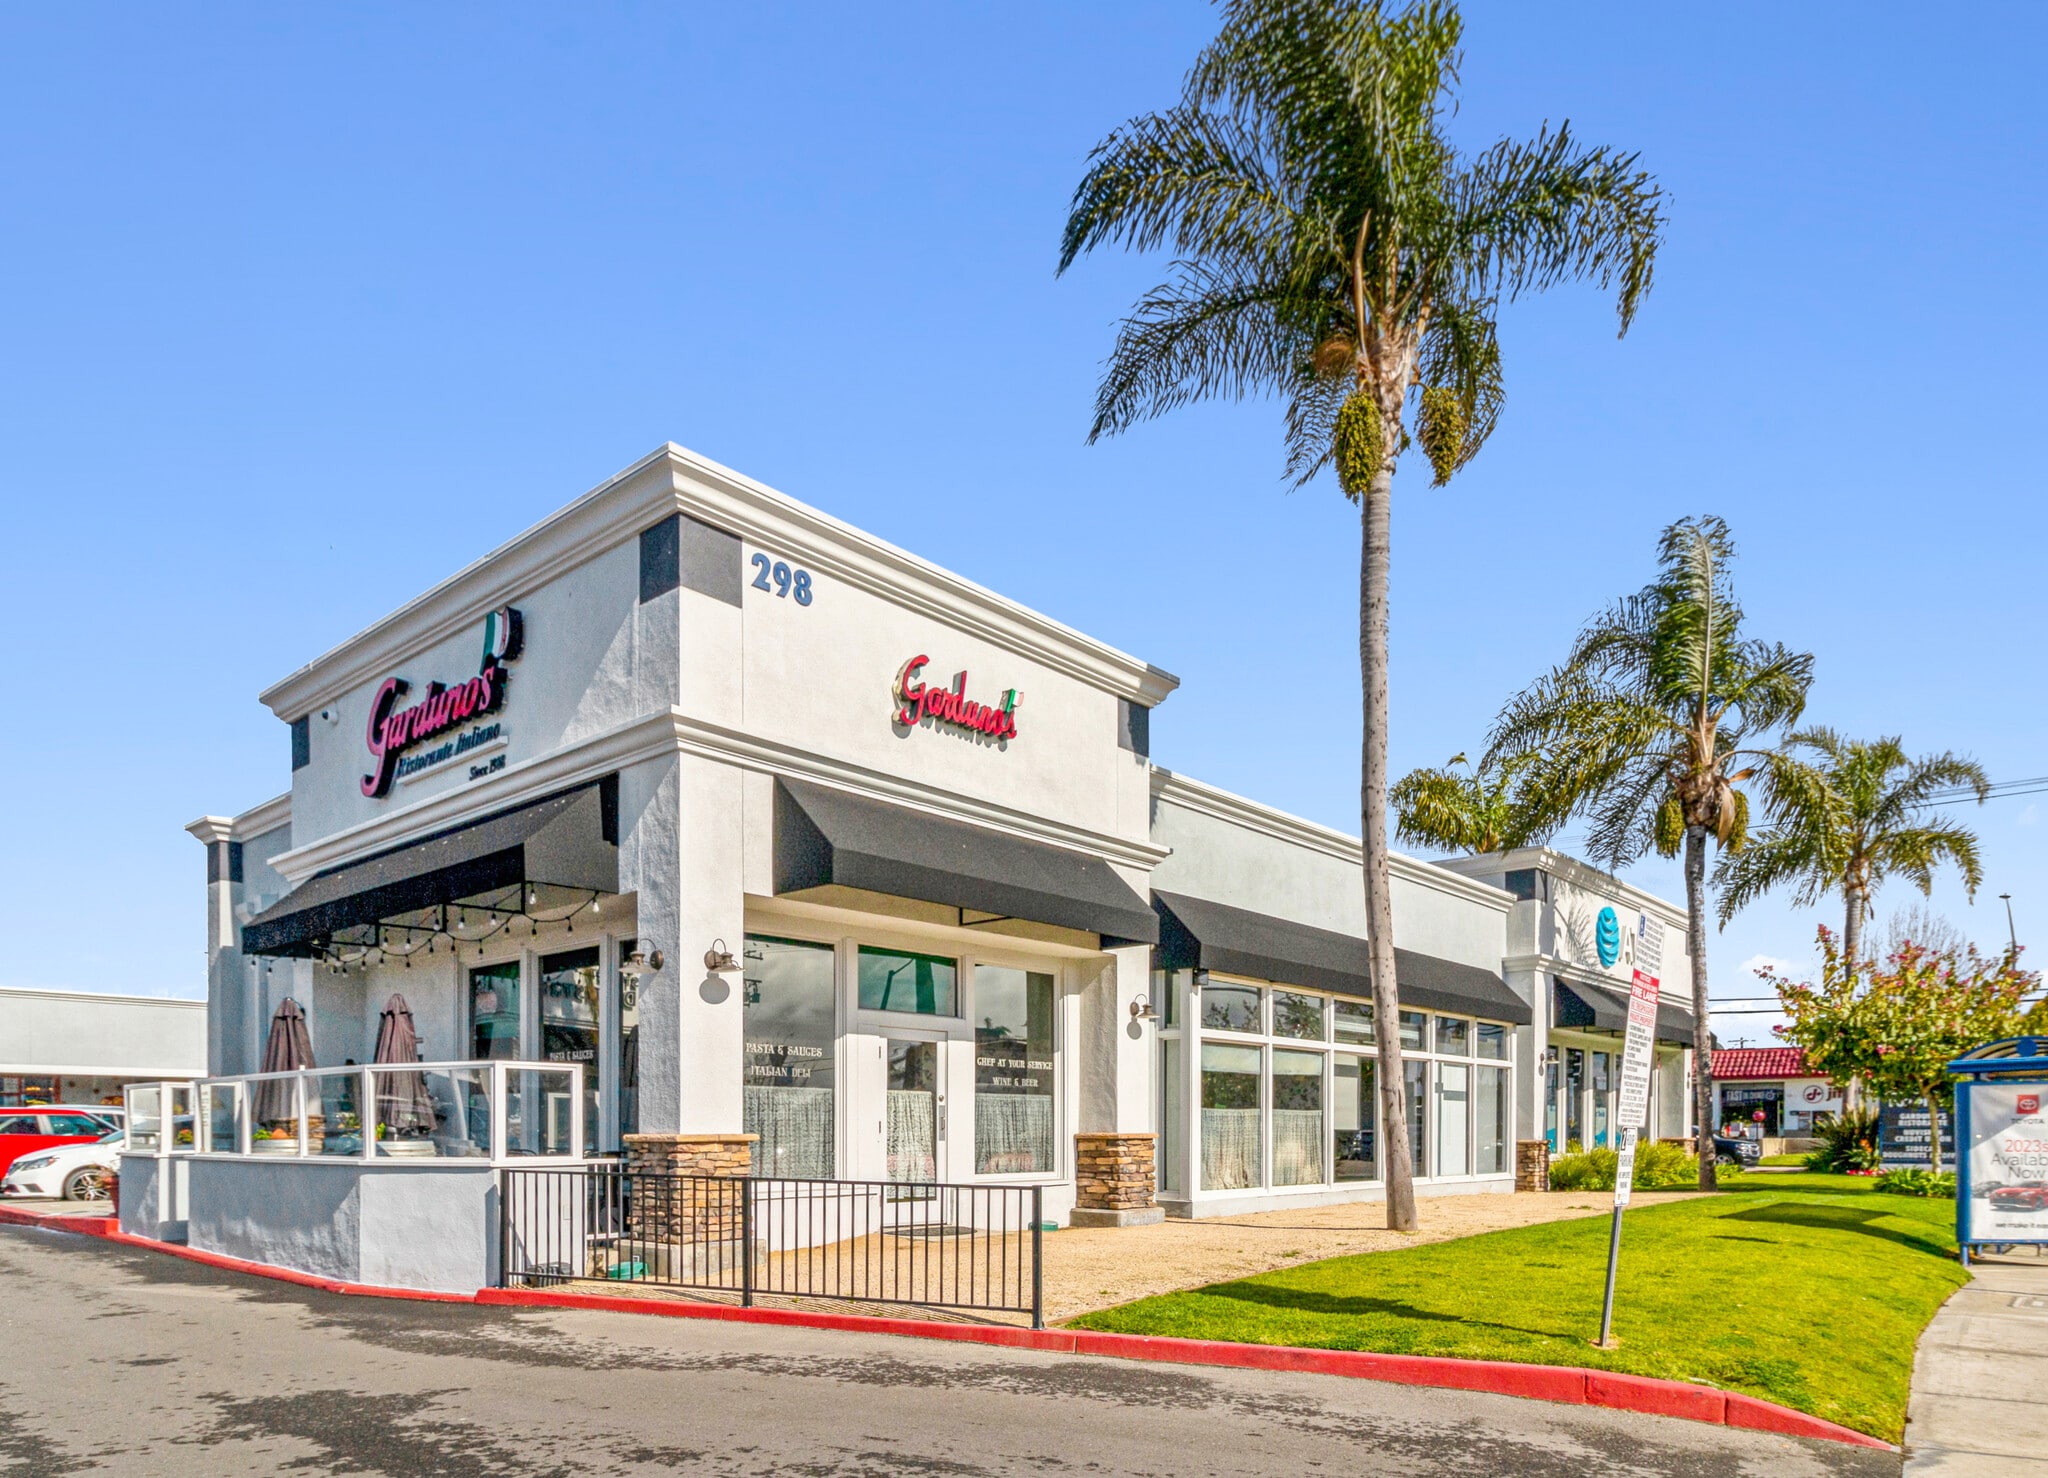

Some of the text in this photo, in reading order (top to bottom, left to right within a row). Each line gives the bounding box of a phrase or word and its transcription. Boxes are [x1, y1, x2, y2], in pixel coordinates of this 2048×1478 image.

[751, 552, 813, 607] 298
[396, 722, 501, 777] Ristorante Italiano
[745, 1042, 823, 1058] PASTA & SAUCES
[976, 1057, 1053, 1070] CHEF AT YOUR SERVICE
[750, 1065, 811, 1078] ITALIAN DELI
[992, 1076, 1012, 1086] WINE
[1021, 1078, 1039, 1087] BEER
[2005, 1139, 2048, 1153] 2023s
[2008, 1166, 2046, 1179] Now
